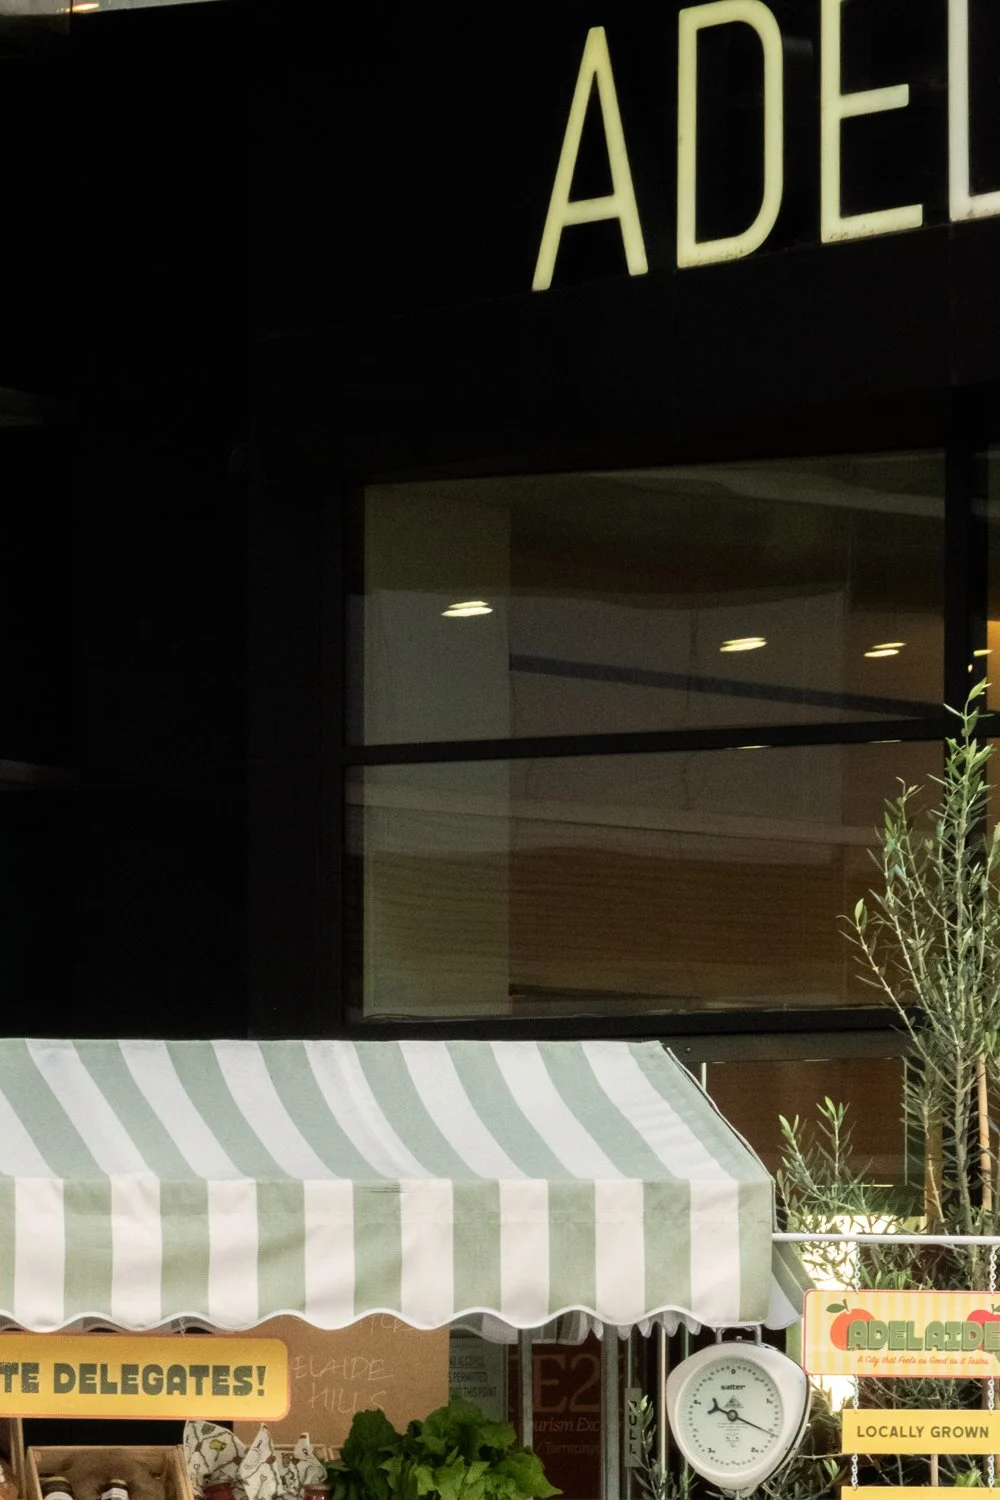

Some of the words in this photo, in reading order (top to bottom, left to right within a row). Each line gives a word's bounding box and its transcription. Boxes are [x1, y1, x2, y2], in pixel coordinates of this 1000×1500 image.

[847, 1320, 1000, 1352] ADELAIDE
[293, 1354, 395, 1381] ELAIDE
[865, 1356, 879, 1367] City
[882, 1355, 897, 1364] that
[898, 1355, 916, 1364] Feels
[929, 1355, 948, 1364] Good
[53, 1363, 267, 1397] DELEGATES!
[857, 1425, 924, 1439] LOCALLY
[930, 1425, 989, 1439] GROWN
